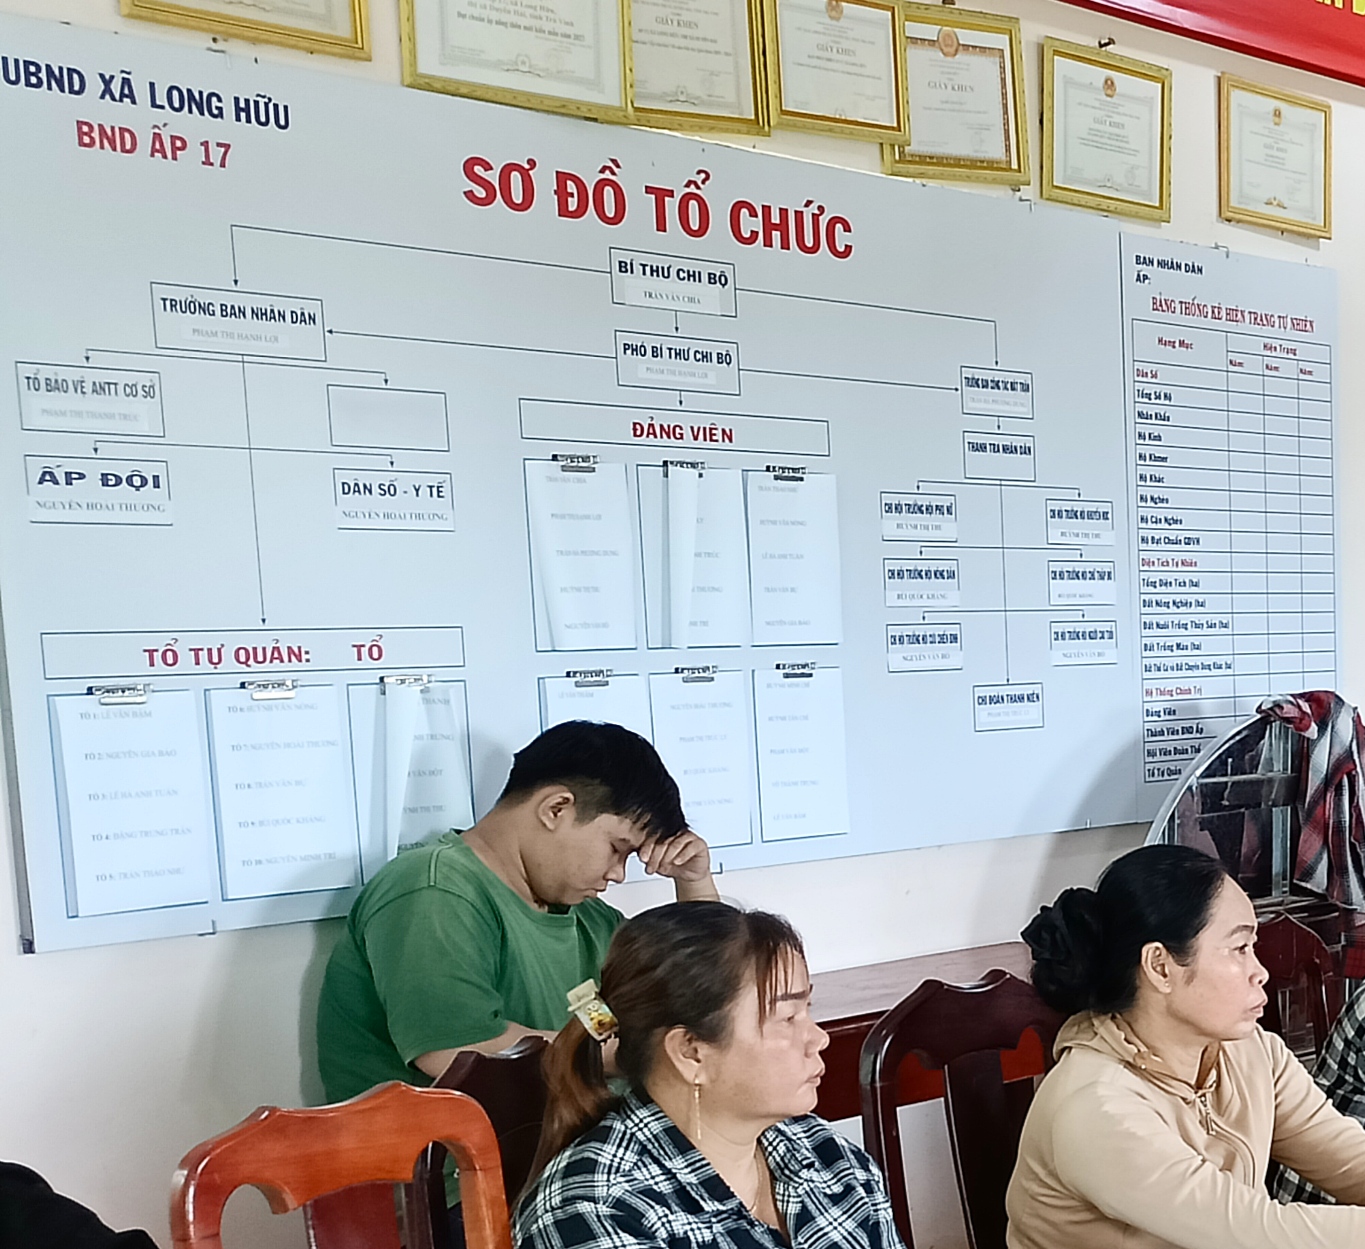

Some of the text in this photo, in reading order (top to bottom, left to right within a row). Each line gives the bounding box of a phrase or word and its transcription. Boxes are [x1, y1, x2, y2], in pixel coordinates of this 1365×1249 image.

[1, 55, 290, 130] UBND XÃ LONG HỮU
[76, 120, 231, 168] BND ẤP 17
[461, 155, 854, 260] SƠ ĐỒ TỔ CHỨC
[617, 258, 729, 288] BÍ THƯ CHI BỘ
[1135, 255, 1203, 275] BAN NHÂN DÂN
[1135, 269, 1151, 284] ẤP:
[161, 295, 316, 326] TRƯỞNG BAN NHÂN DÂN
[1152, 292, 1315, 333] BẢNG THỐNG KÊ HIỆN TRẠNG TỰ NHIÊN
[622, 341, 732, 367] PHÓ BÍ THƯ CHI BỘ
[1157, 337, 1176, 349] Hạng
[24, 368, 155, 400] TỔ BẢO VỆ ANTT CƠ SỞ
[1154, 389, 1163, 401] Số
[632, 416, 733, 443] ĐẢNG VIÊN
[37, 464, 161, 491] ẤP ĐỘI
[341, 478, 372, 497] DÂN
[378, 478, 397, 498] SỐ
[412, 484, 423, 498] Y
[427, 480, 446, 499] TẾ
[143, 637, 311, 670] TỔ TỰ QUẢN:
[352, 635, 384, 663] TỔ
